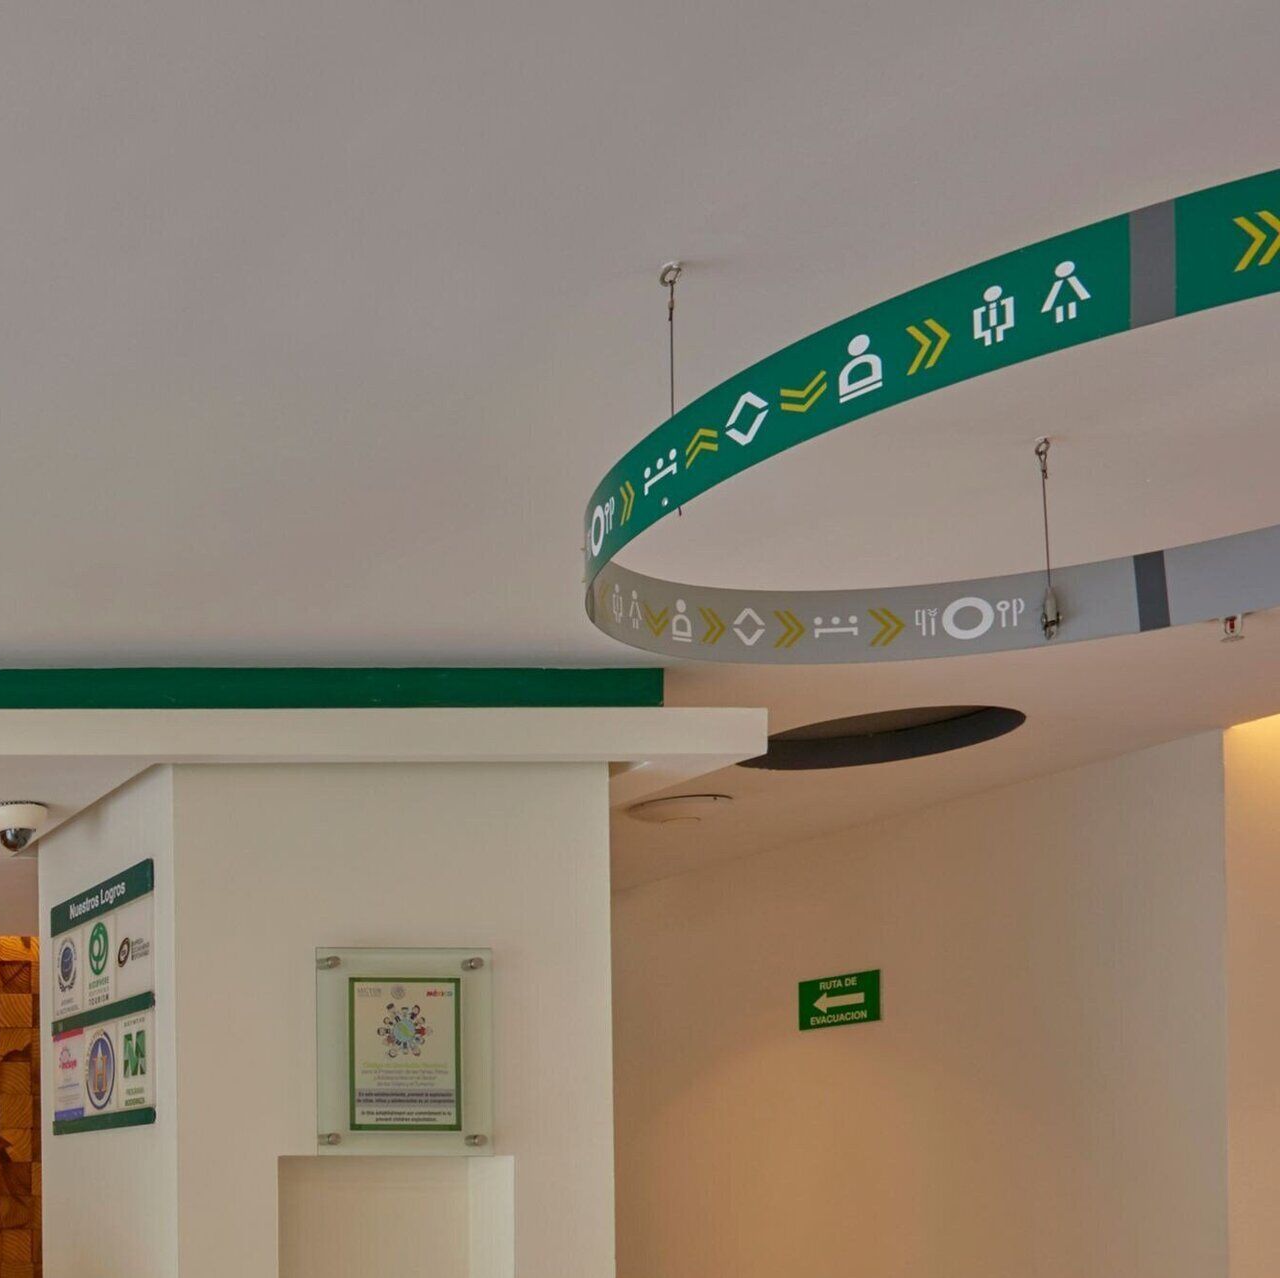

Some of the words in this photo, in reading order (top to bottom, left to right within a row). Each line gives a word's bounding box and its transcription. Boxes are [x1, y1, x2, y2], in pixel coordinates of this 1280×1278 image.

[69, 894, 99, 920] Nuestros
[101, 882, 126, 905] Logros
[819, 980, 843, 991] RUTA
[844, 976, 858, 987] DE
